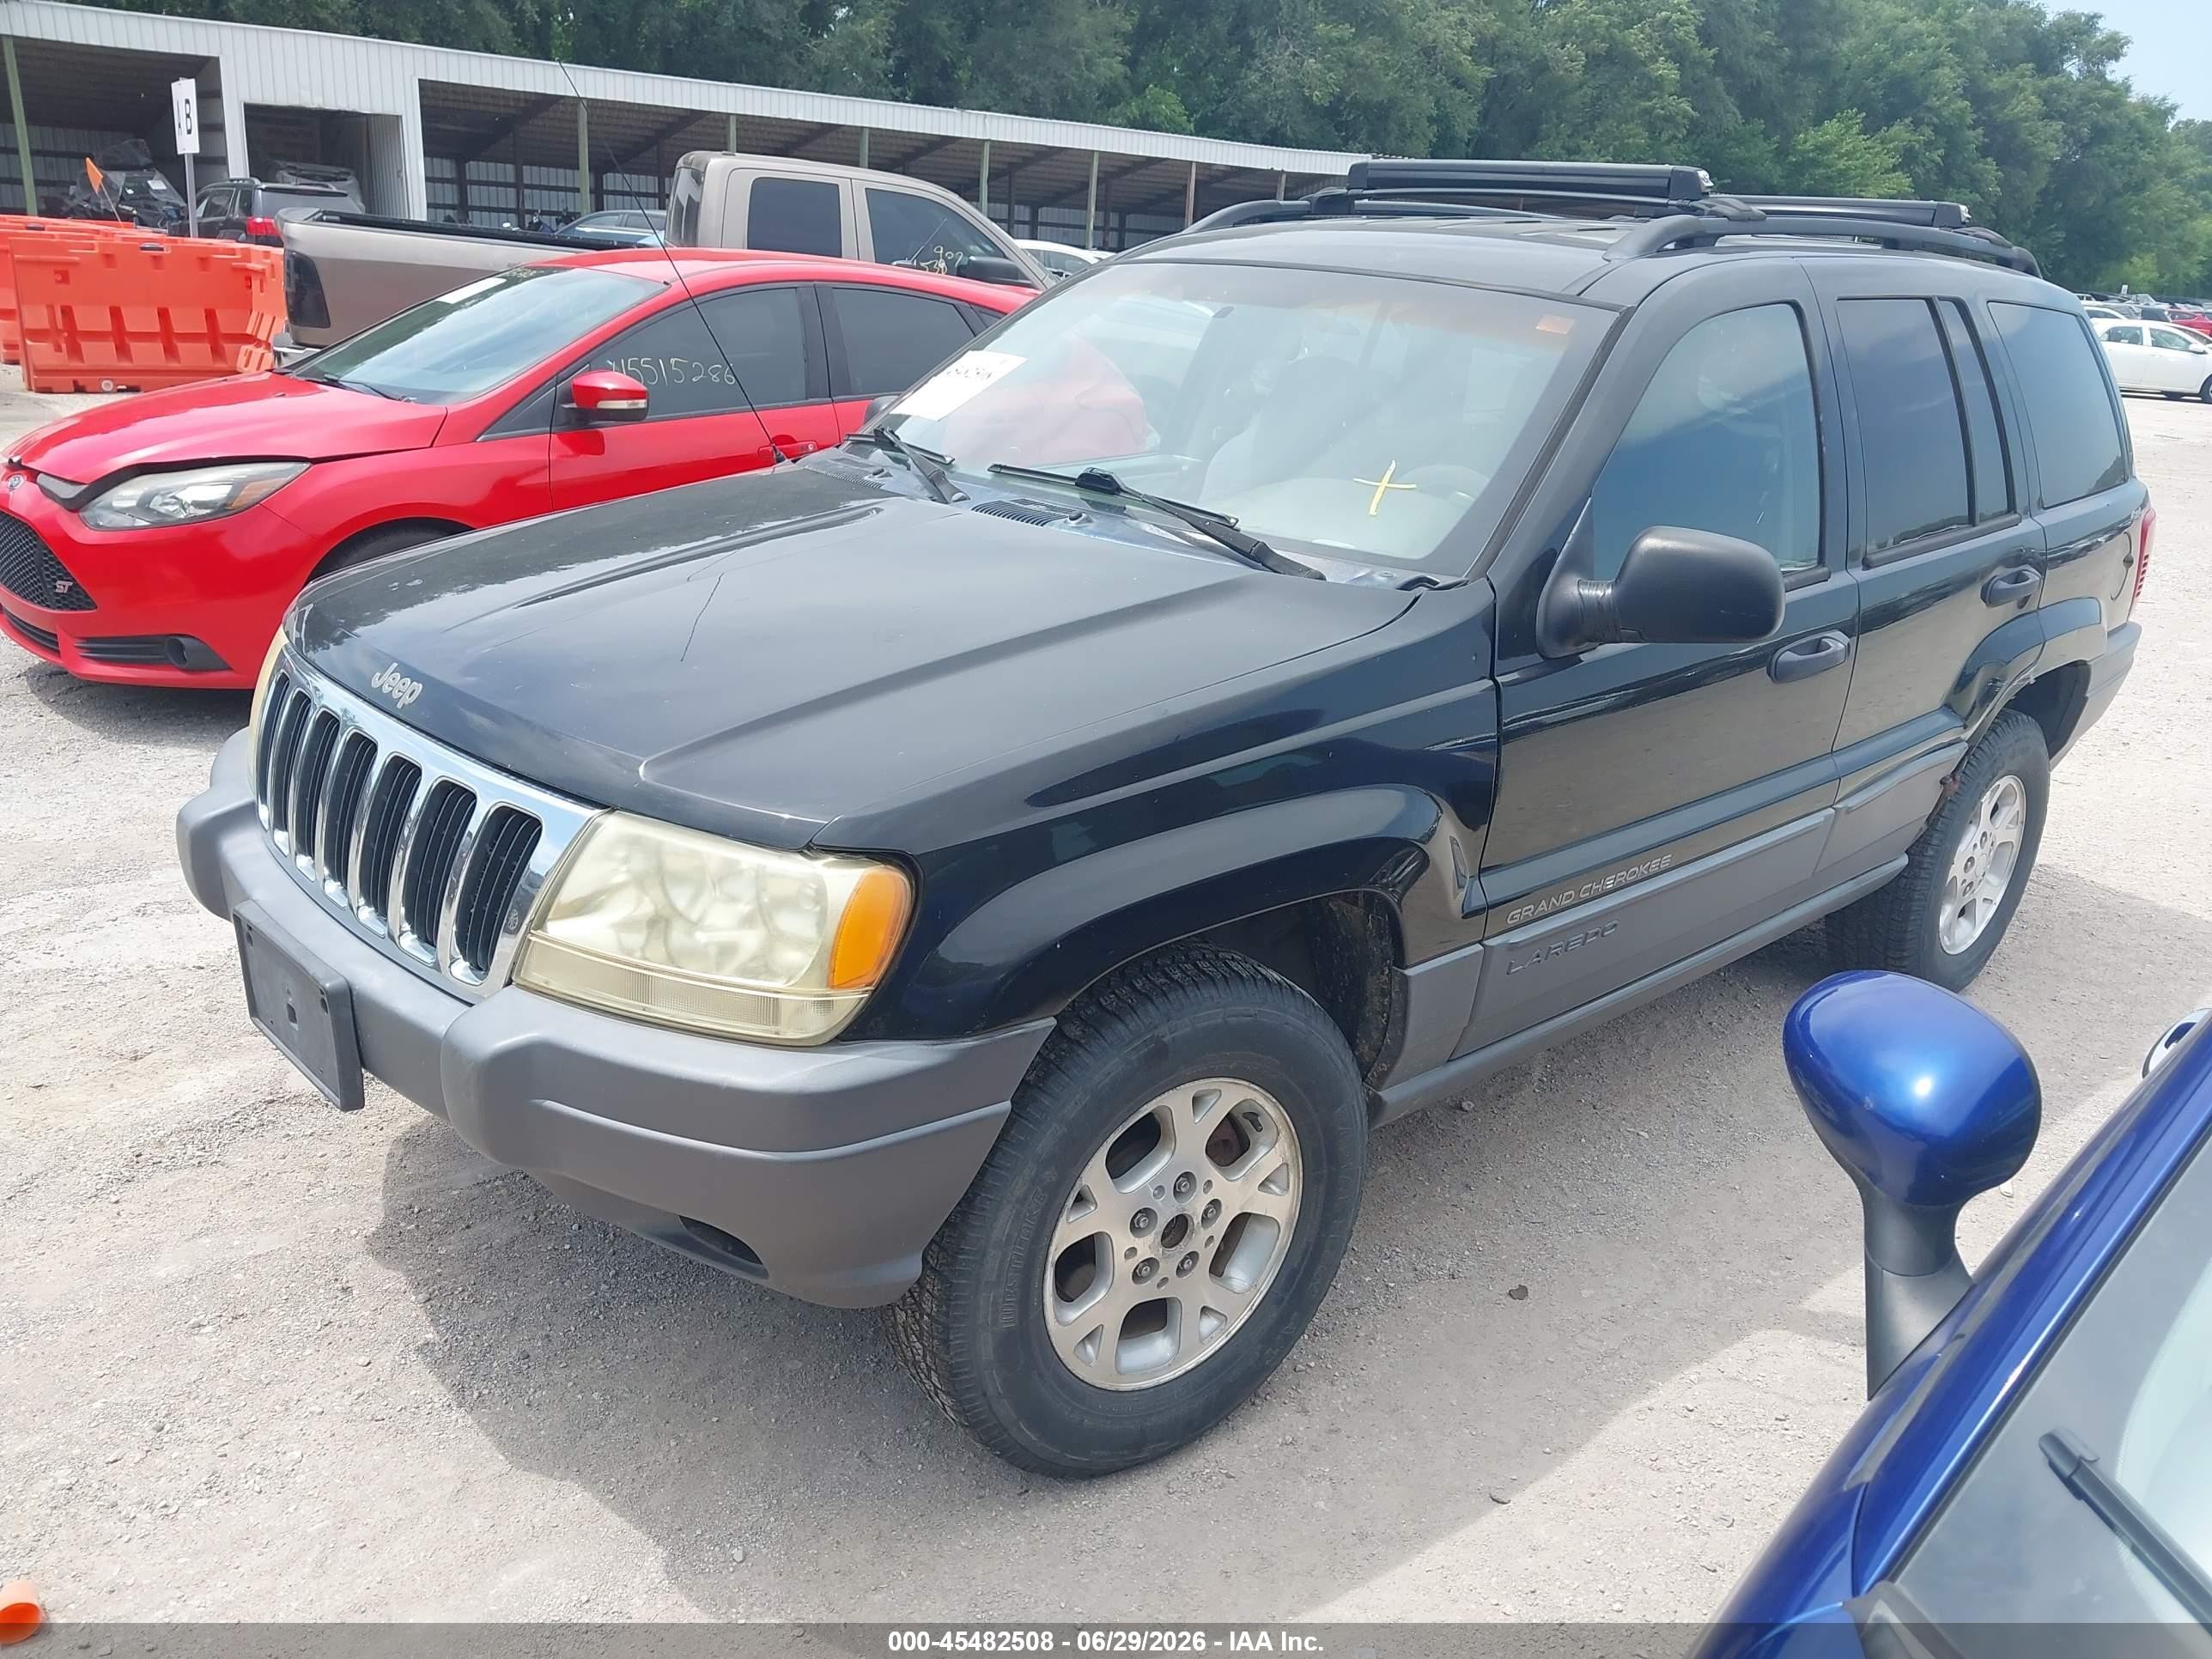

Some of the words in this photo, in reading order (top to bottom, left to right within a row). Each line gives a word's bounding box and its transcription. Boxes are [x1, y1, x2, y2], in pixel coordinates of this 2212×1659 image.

[185, 99, 192, 135] B
[55, 580, 74, 594] ST
[371, 662, 422, 708] Jeep
[1506, 890, 1575, 924] GRAND
[1579, 854, 1673, 898] CHEROKEE
[1505, 919, 1620, 975] LAREDO
